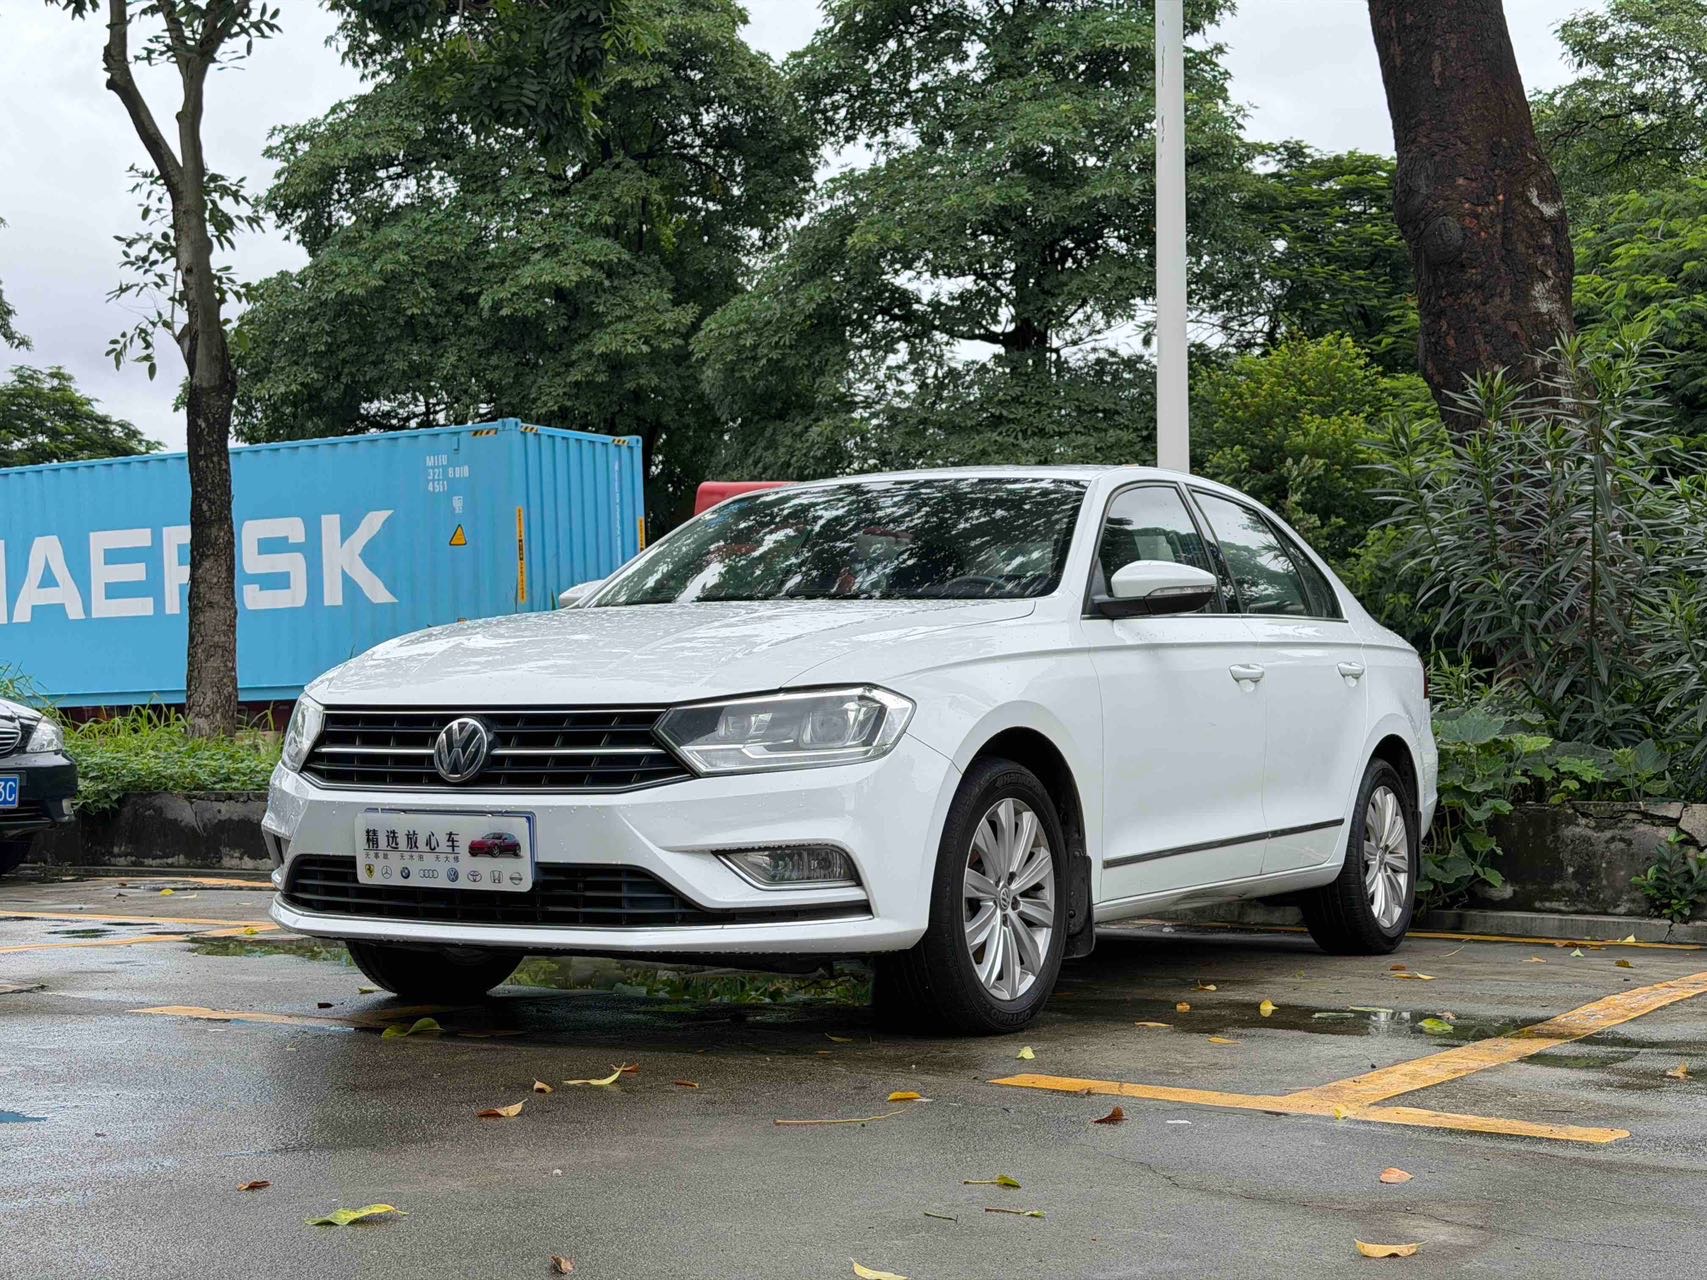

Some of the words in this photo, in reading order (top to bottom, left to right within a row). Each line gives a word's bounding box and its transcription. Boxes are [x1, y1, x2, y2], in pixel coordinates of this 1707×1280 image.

[427, 467, 443, 480] 321
[0, 509, 399, 624] AESK
[365, 828, 460, 852] 精选放心车
